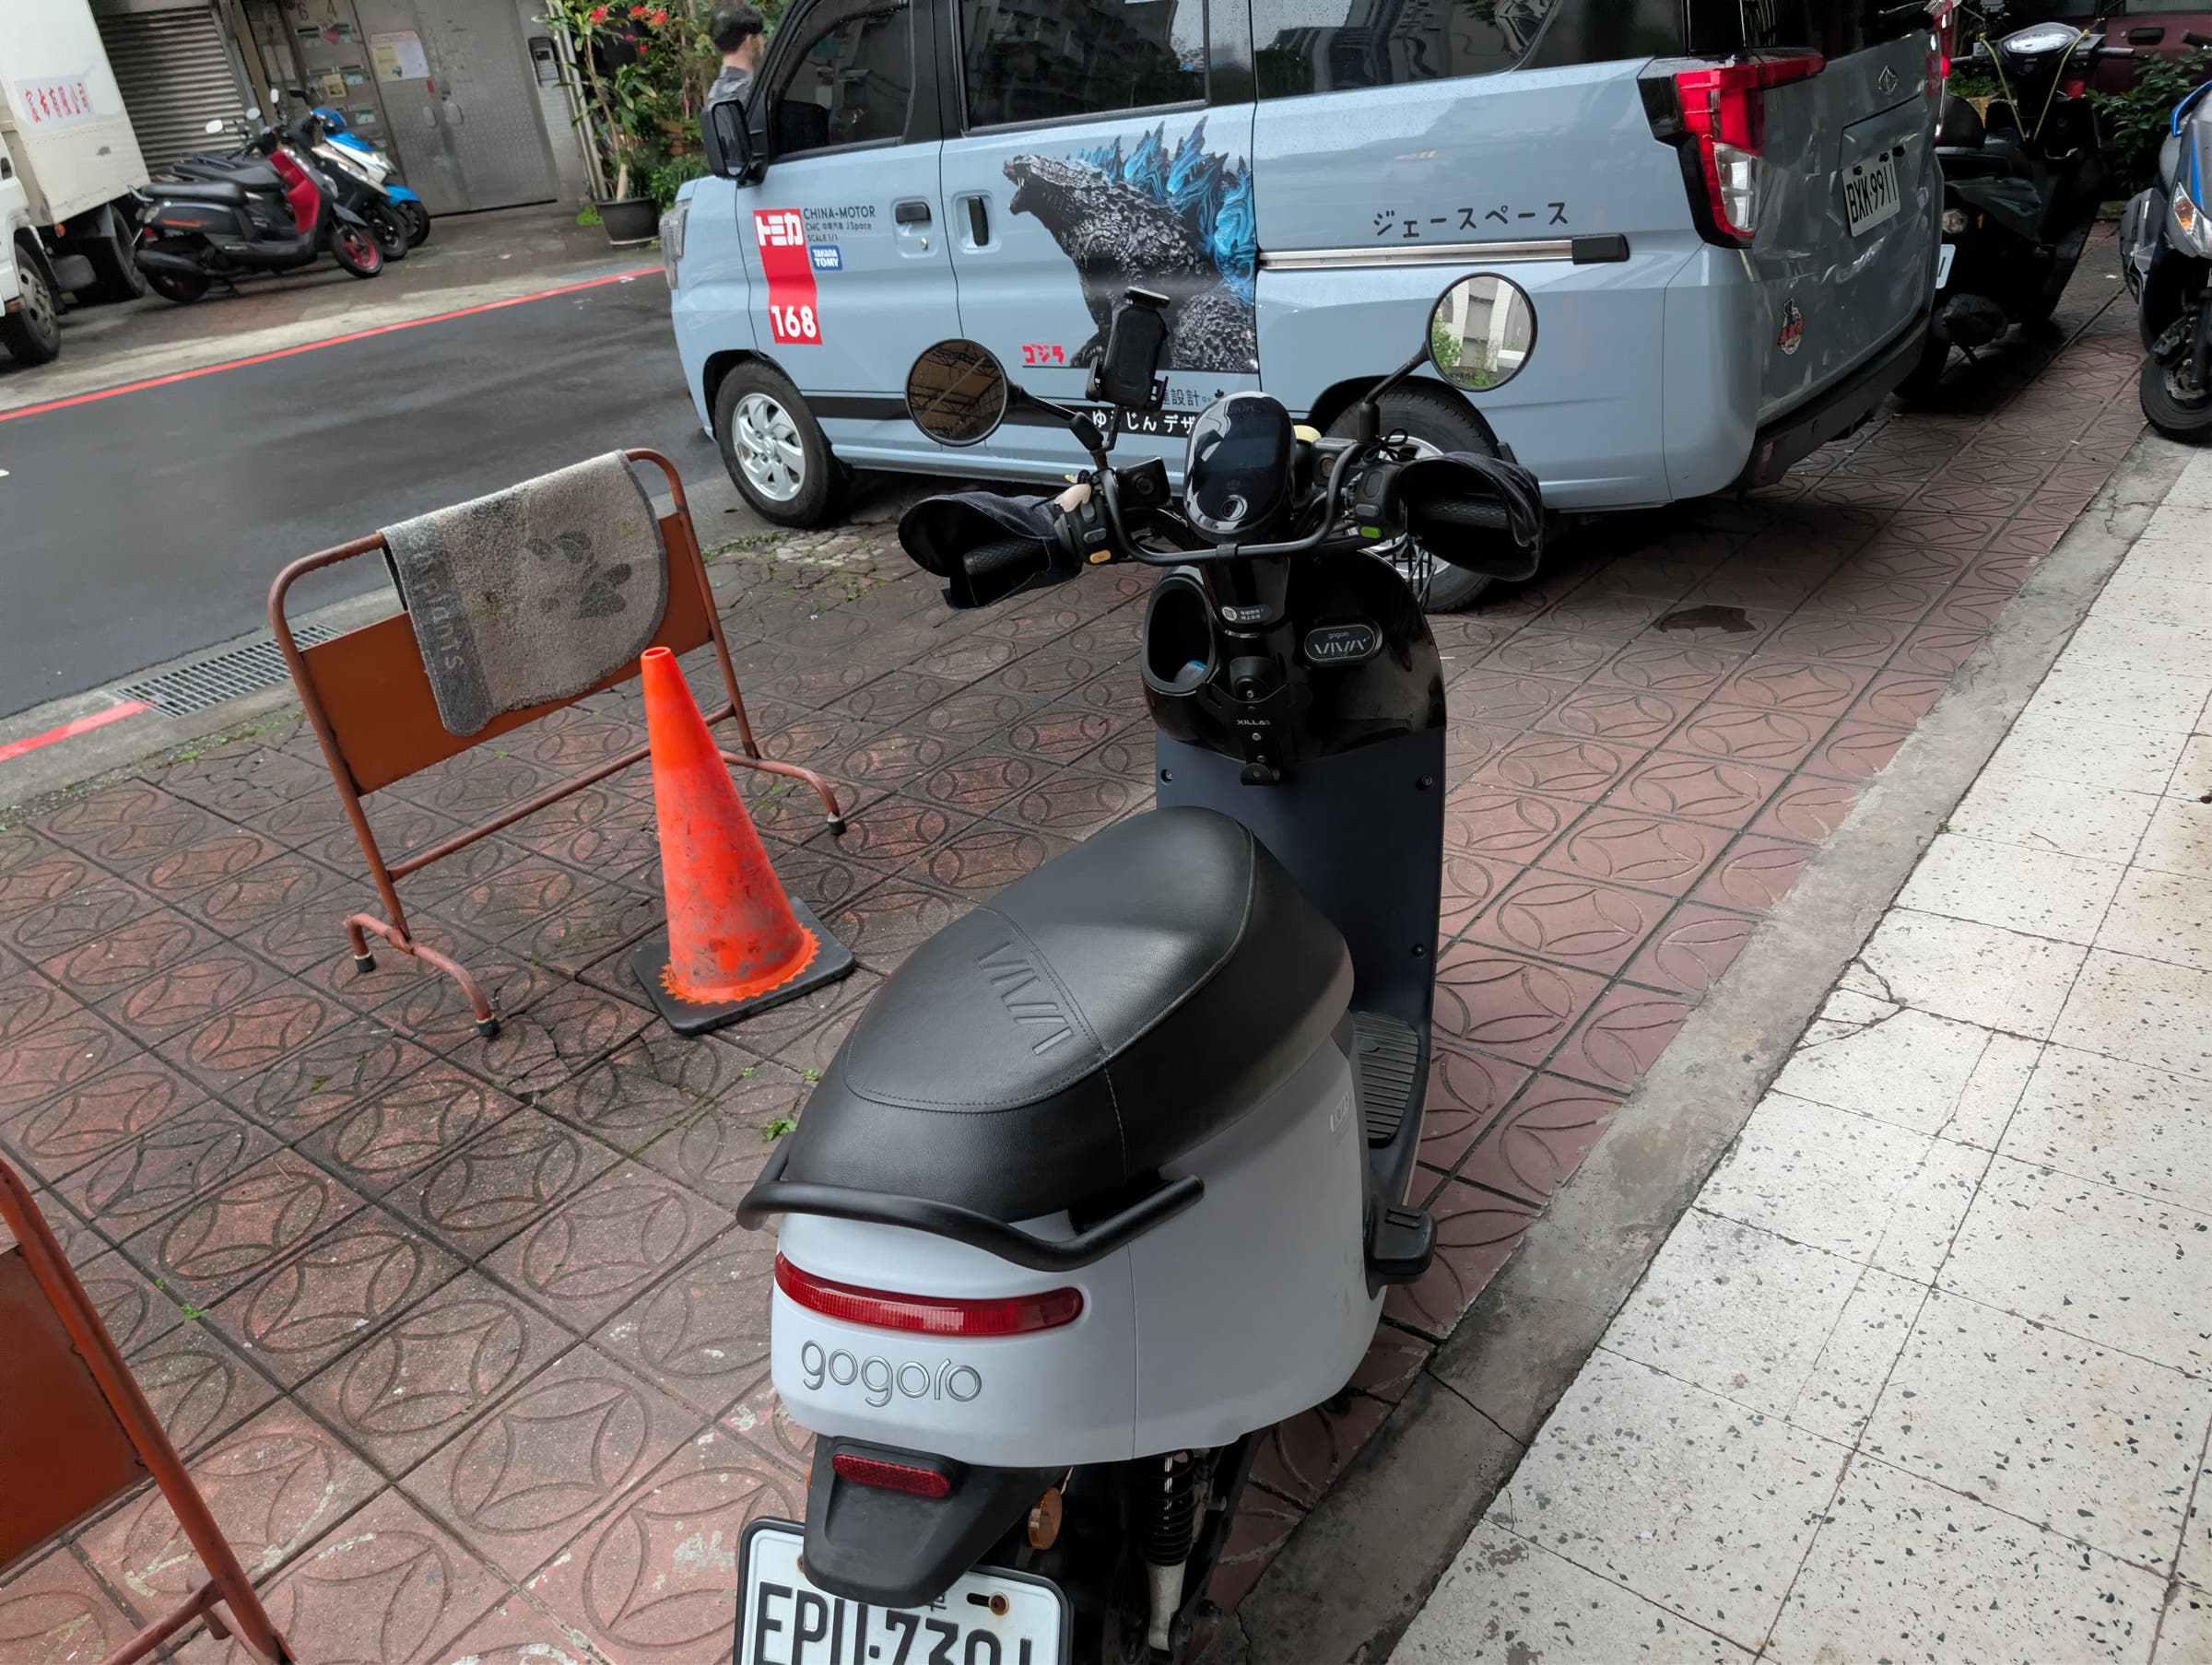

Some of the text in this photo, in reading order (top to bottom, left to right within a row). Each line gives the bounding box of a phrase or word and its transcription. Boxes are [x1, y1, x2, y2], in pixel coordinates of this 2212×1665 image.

[1846, 166, 1898, 224] BXK-9911
[803, 205, 876, 219] CHINA-MOTOR
[1373, 202, 1568, 238] ジェースペース
[755, 212, 804, 246] トミカ
[806, 223, 820, 231] CMC
[807, 234, 827, 242] SCALE
[812, 249, 839, 258] TAKARA
[814, 257, 839, 267] TOMY
[771, 305, 817, 338] 168
[1022, 344, 1065, 364] ゴジラ
[1092, 409, 1158, 433] ゆじん
[1313, 639, 1365, 655] VIVA
[801, 1340, 982, 1408] gogoro
